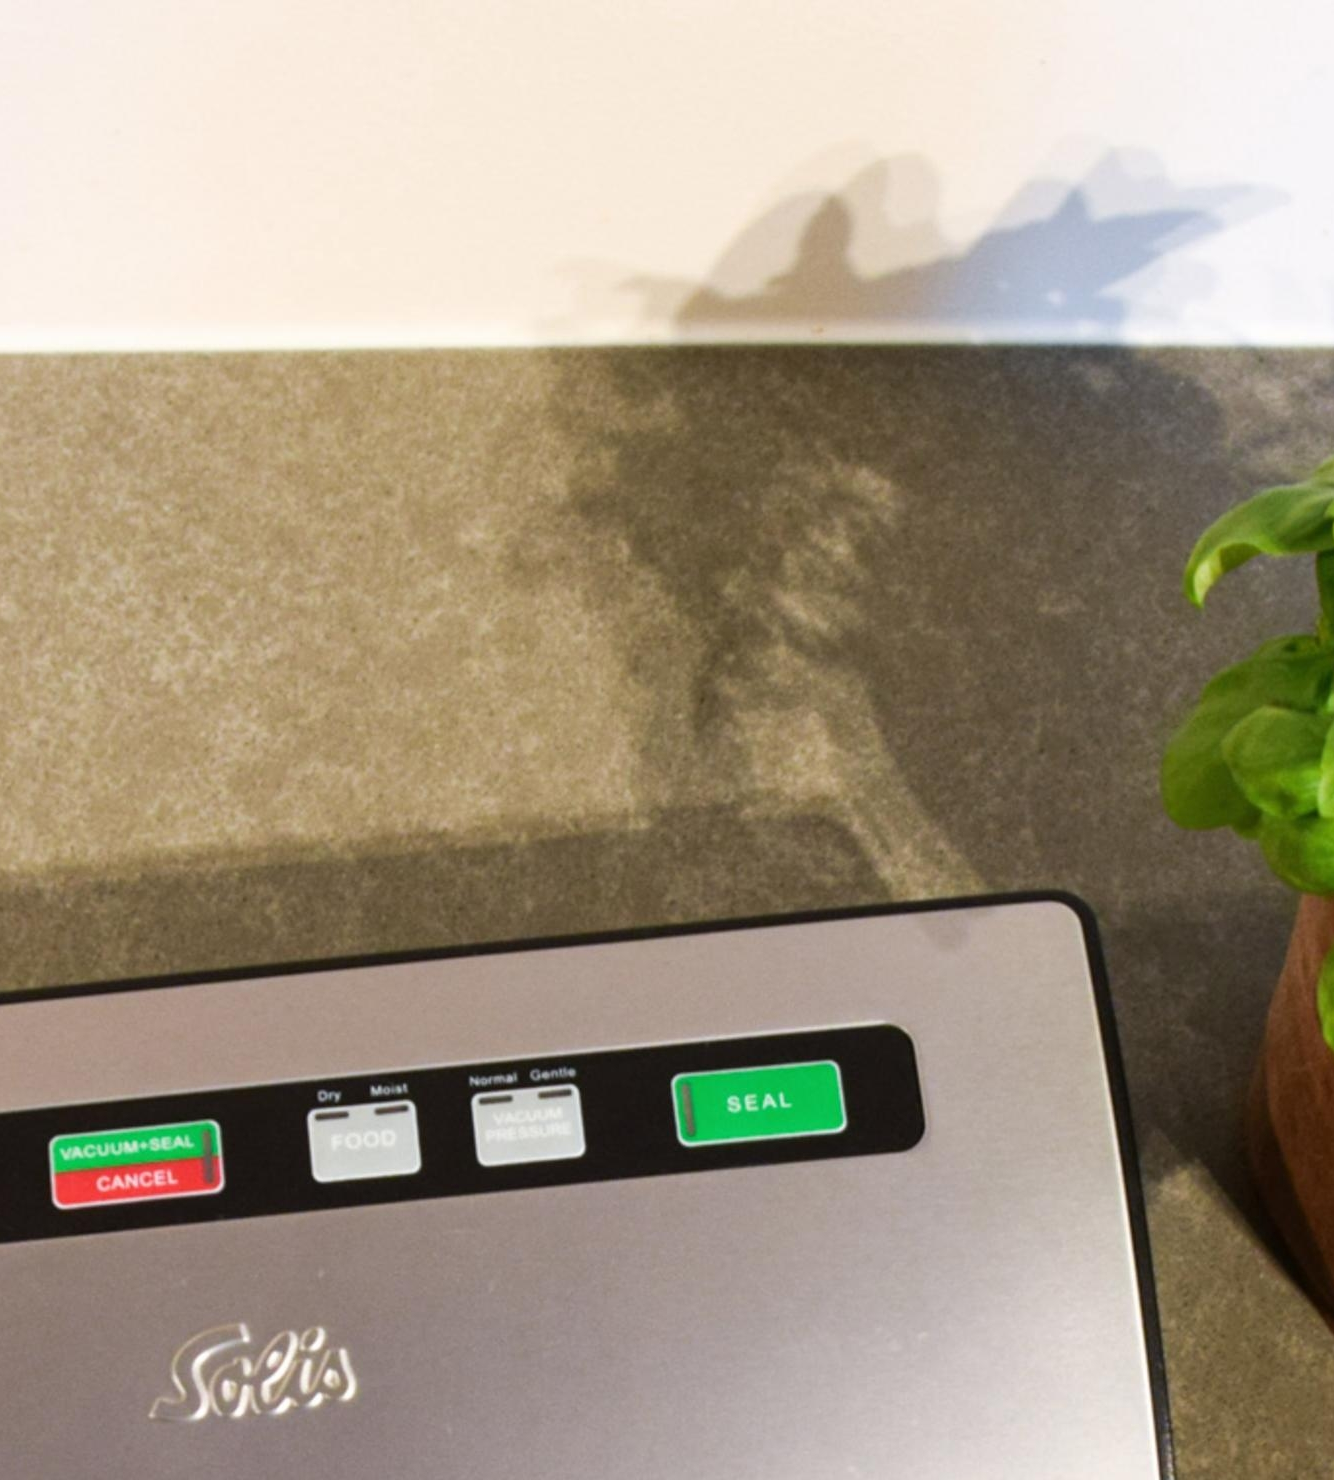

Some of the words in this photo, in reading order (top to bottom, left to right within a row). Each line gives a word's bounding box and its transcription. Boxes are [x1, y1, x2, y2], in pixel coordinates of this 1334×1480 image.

[468, 1072, 518, 1088] Normal
[529, 1066, 577, 1082] Gentle
[317, 1090, 342, 1104] Dry
[370, 1083, 409, 1097] Moist
[726, 1092, 793, 1113] SEAL
[491, 1107, 565, 1126] VACUUM
[330, 1129, 398, 1151] FOOD
[484, 1121, 573, 1143] PRESSURE
[59, 1134, 195, 1161] VACUUM+SEAL
[96, 1169, 178, 1193] CANCEL
[147, 1321, 359, 1422] Solis
